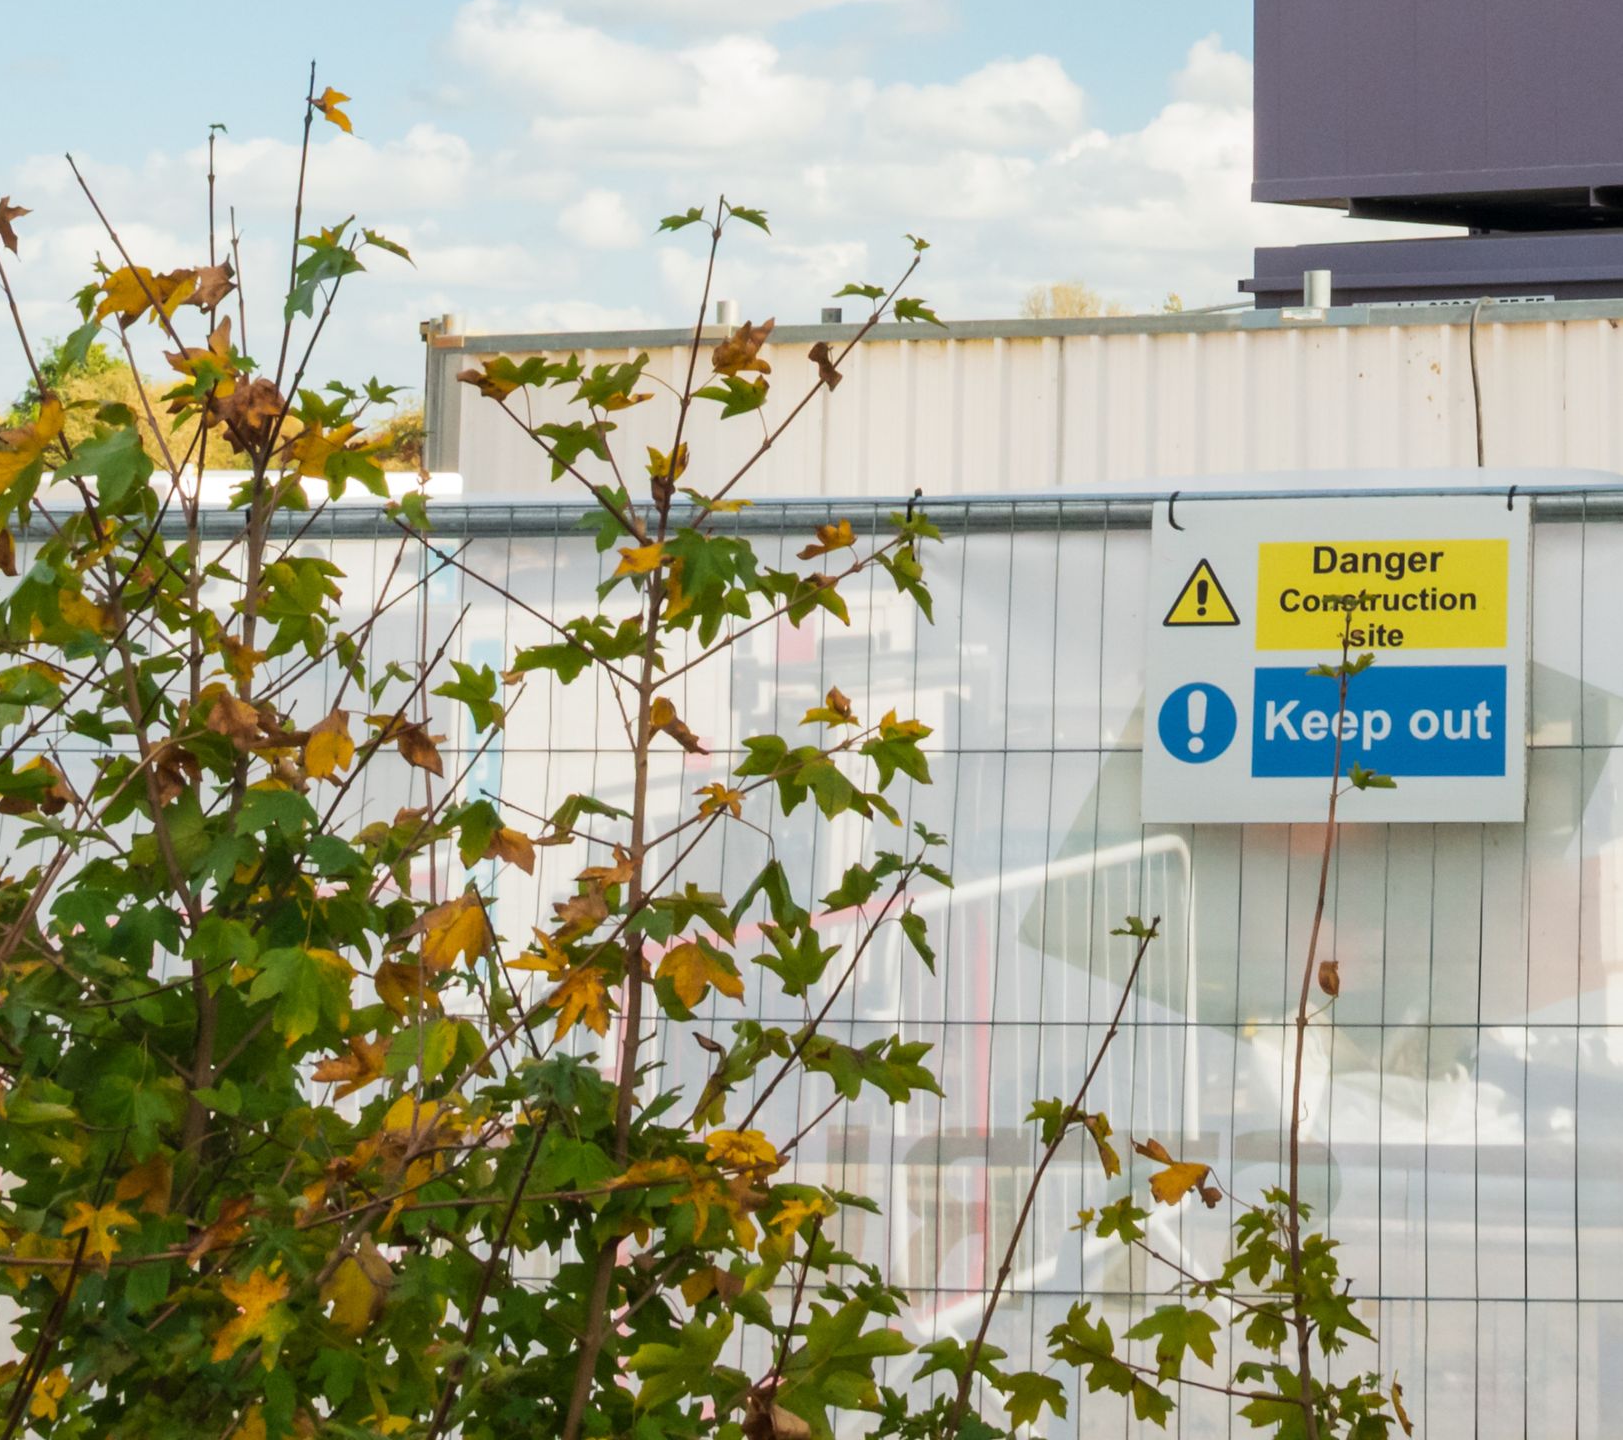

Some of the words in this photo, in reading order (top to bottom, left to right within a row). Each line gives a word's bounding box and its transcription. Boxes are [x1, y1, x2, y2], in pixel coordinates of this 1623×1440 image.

[1313, 545, 1444, 581] Danger
[1279, 587, 1477, 613] Construction
[1350, 623, 1404, 647] site
[1265, 700, 1392, 751] Keep
[1409, 700, 1492, 740] out
